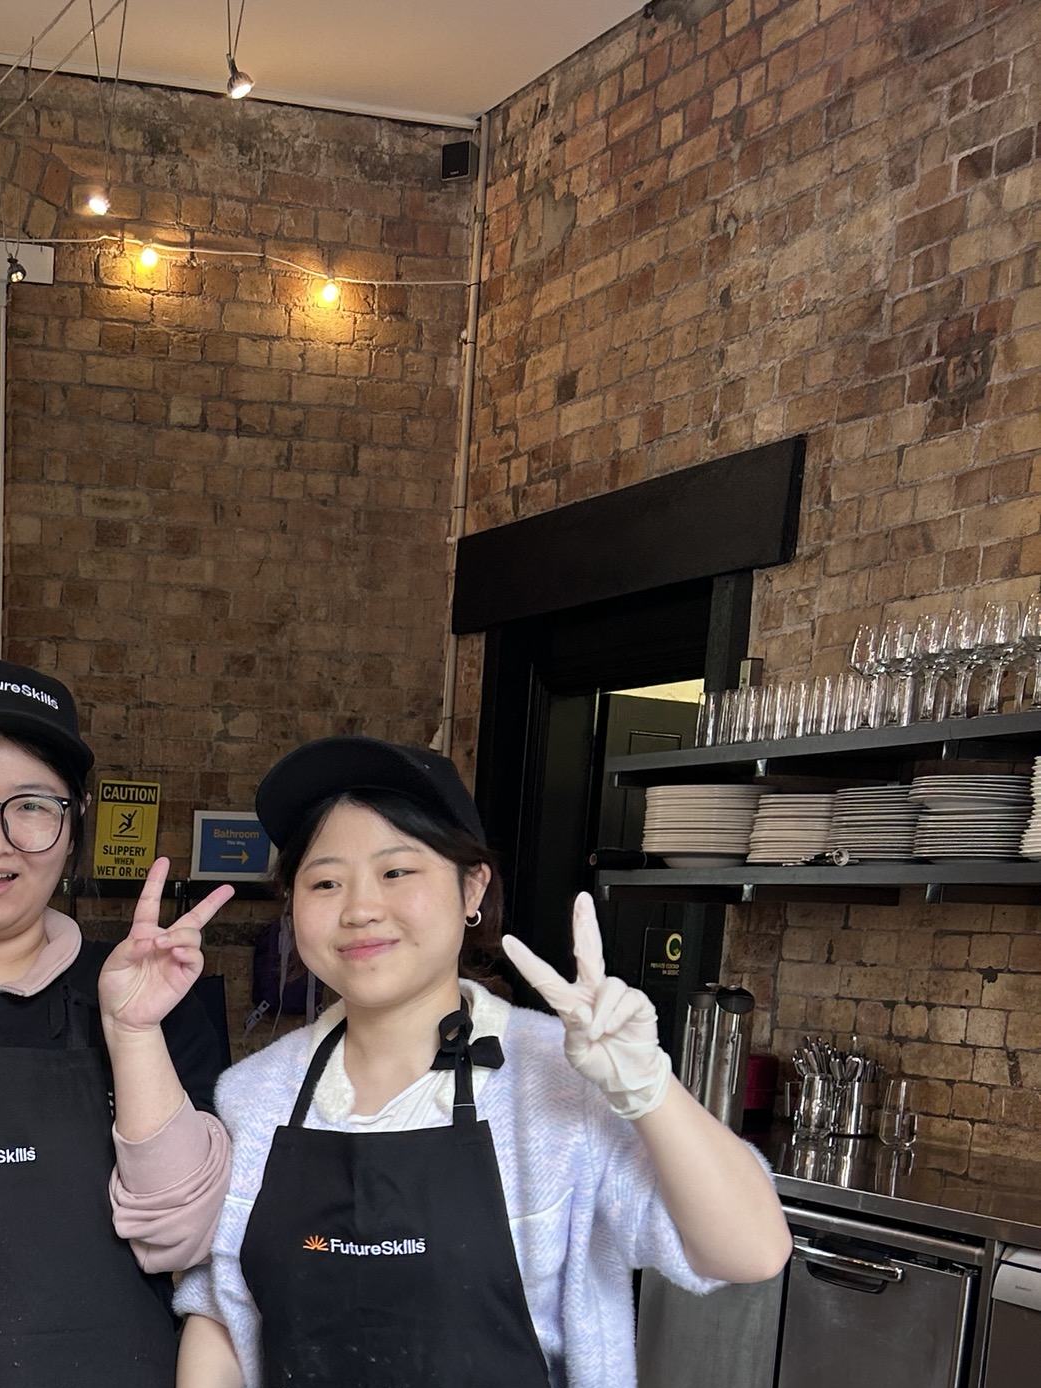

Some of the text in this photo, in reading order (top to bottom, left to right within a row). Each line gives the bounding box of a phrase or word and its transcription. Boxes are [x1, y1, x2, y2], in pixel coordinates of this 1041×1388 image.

[102, 785, 157, 803] CAUTION
[213, 828, 260, 839] Bathroom
[102, 844, 147, 857] SLIPPERY
[114, 857, 135, 866] WHEN
[96, 865, 116, 876] WET
[119, 866, 132, 877] OR
[329, 1238, 426, 1256] FutureSkills
